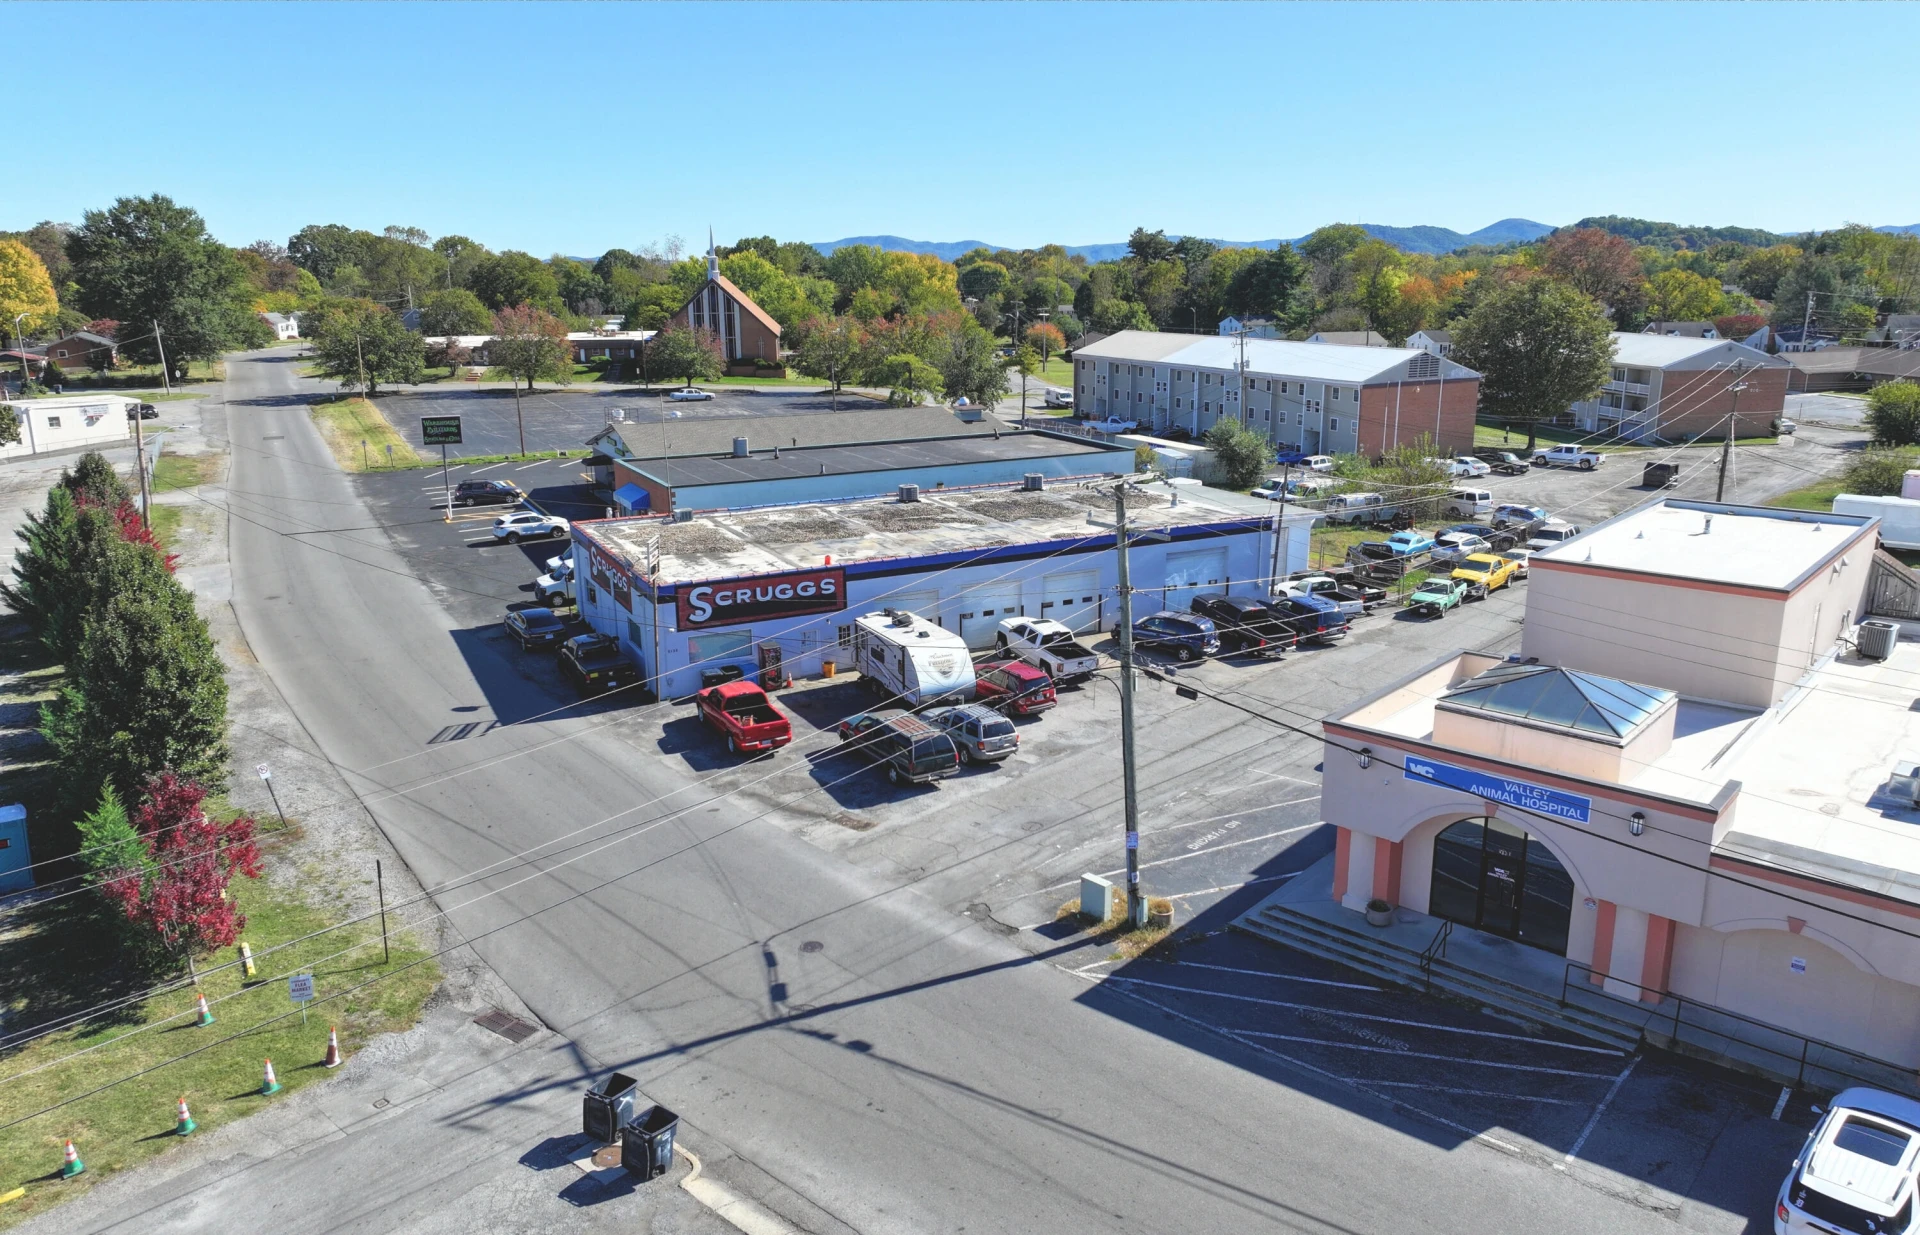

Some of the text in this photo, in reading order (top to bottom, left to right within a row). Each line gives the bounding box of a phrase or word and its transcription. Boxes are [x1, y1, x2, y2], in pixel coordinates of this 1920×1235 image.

[688, 578, 836, 622] SCRUGGS
[1469, 784, 1584, 820] ANIMAL HOSPITAL
[1503, 781, 1551, 800] VALLEY
